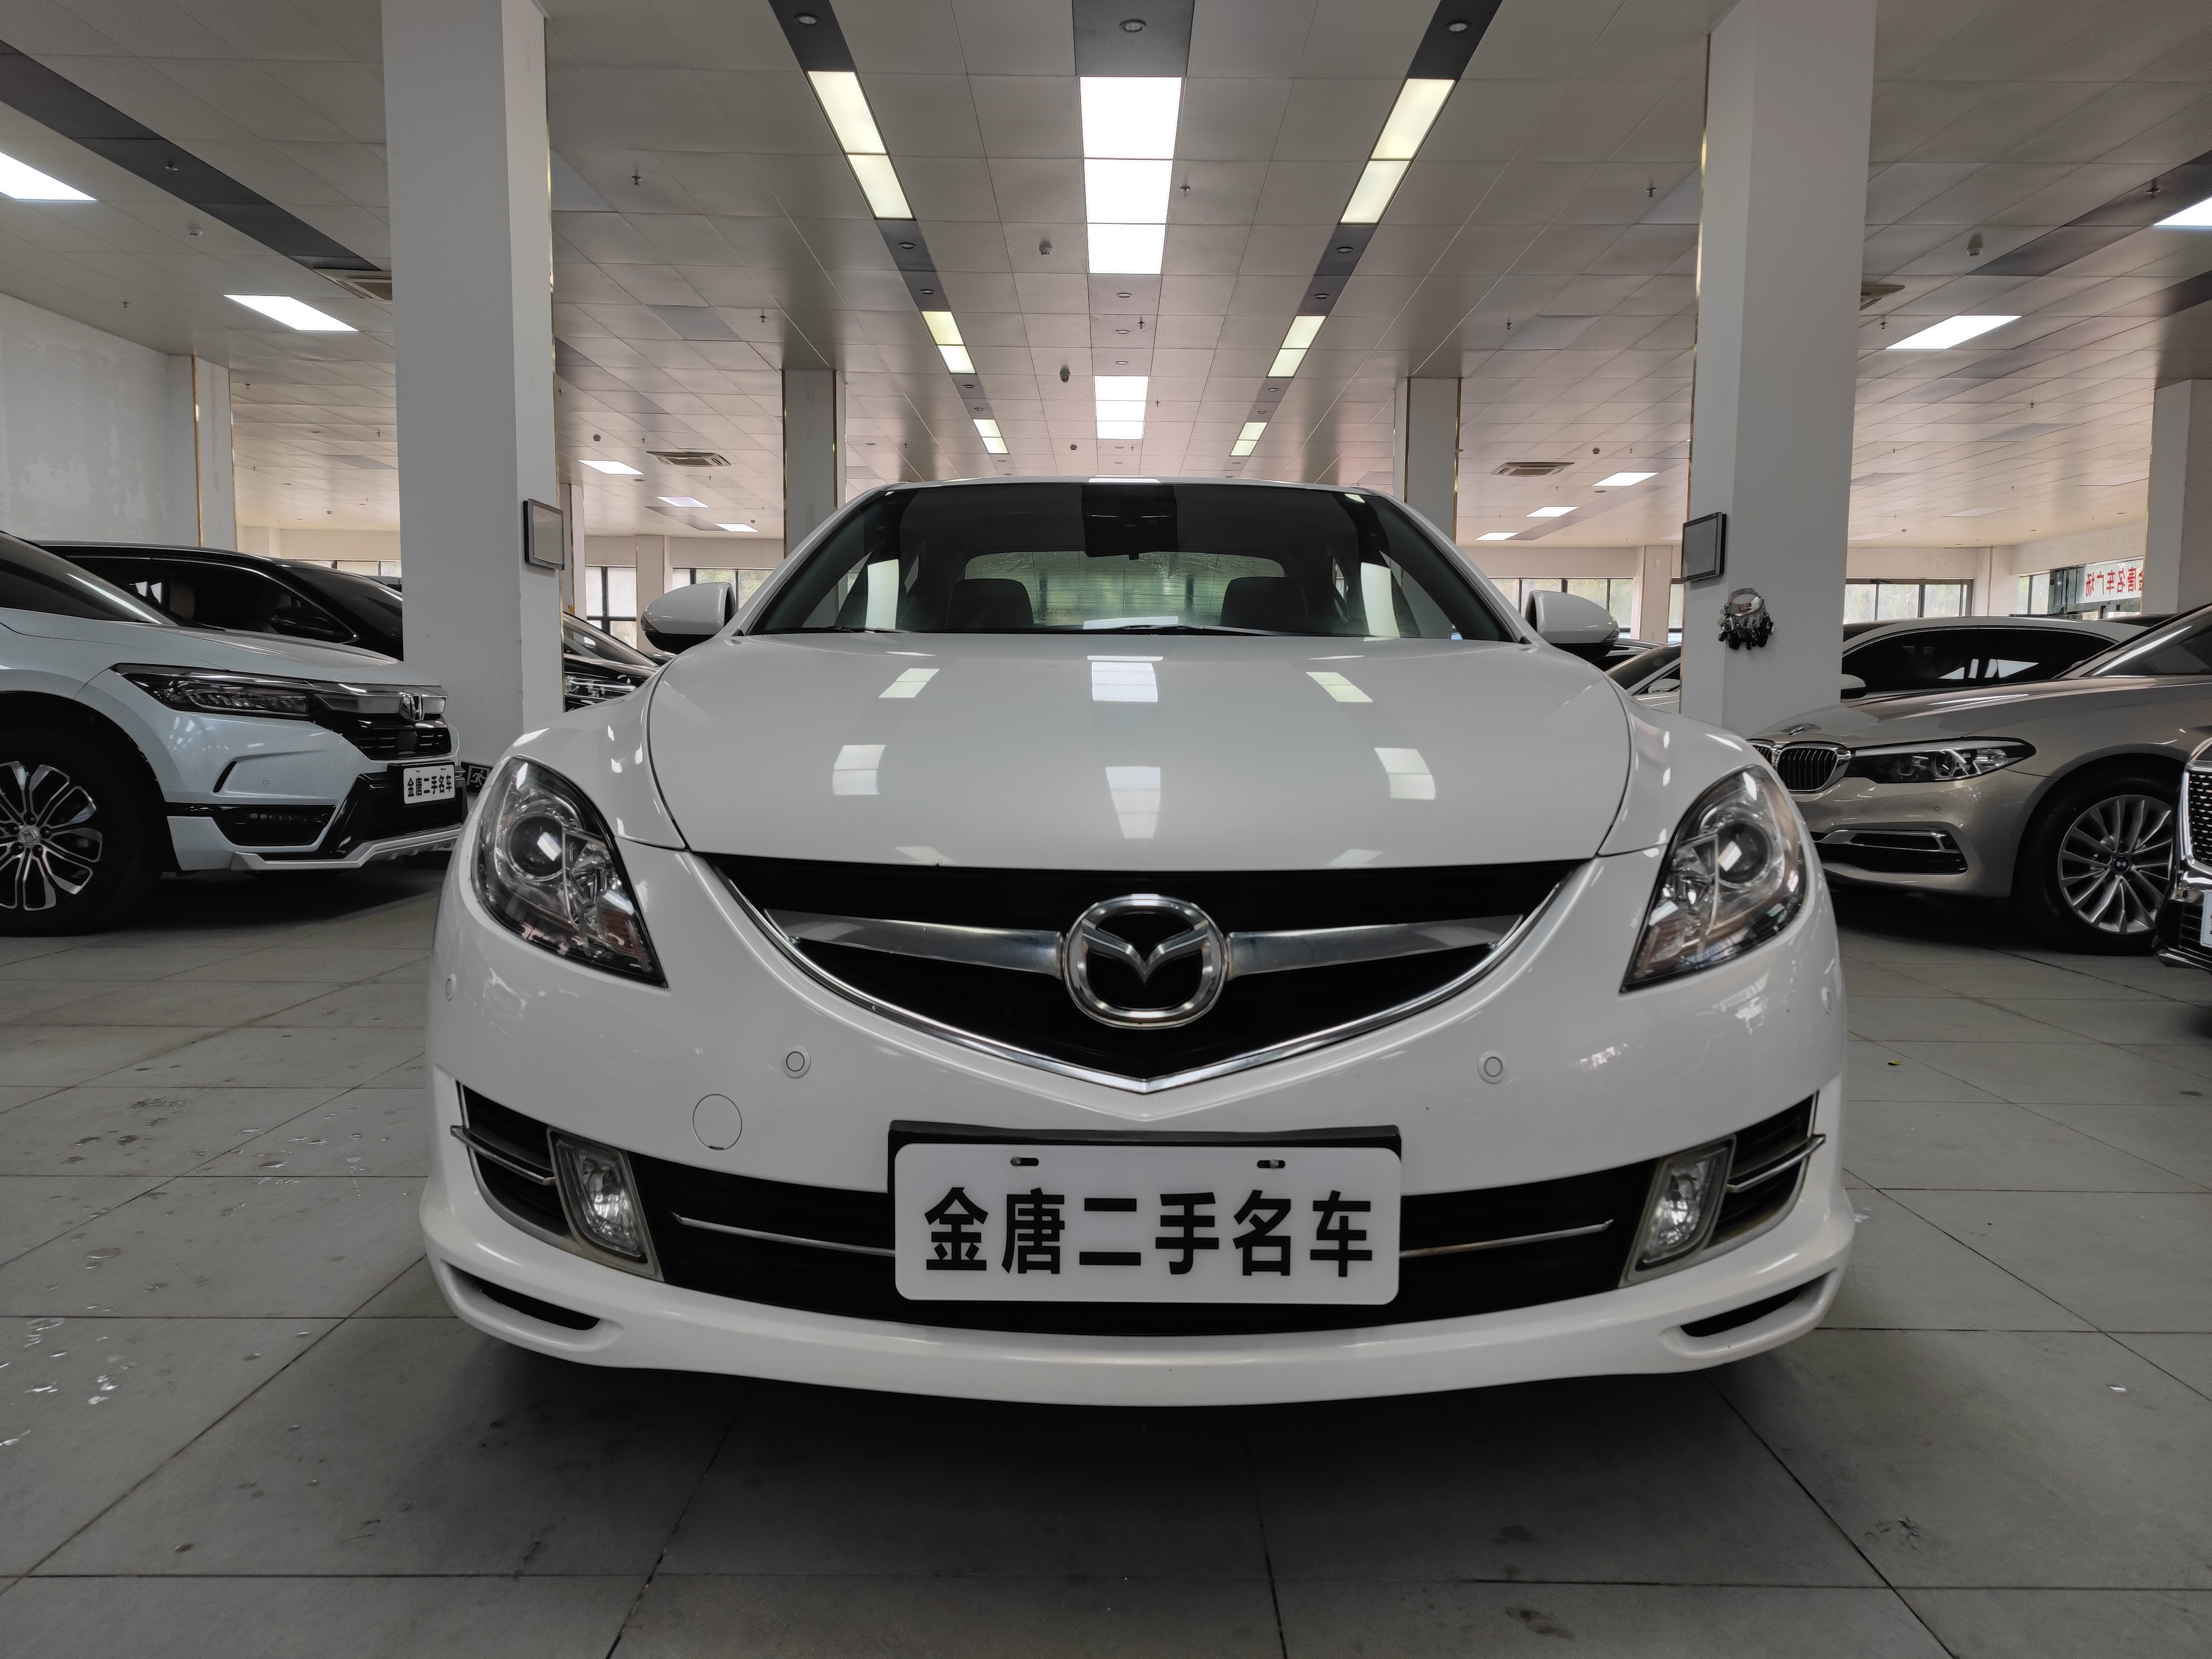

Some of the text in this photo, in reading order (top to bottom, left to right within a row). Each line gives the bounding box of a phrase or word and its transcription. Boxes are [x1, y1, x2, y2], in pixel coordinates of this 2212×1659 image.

[407, 774, 452, 797] 金唐二手名车
[924, 1187, 1373, 1277] 金唐二手名车
